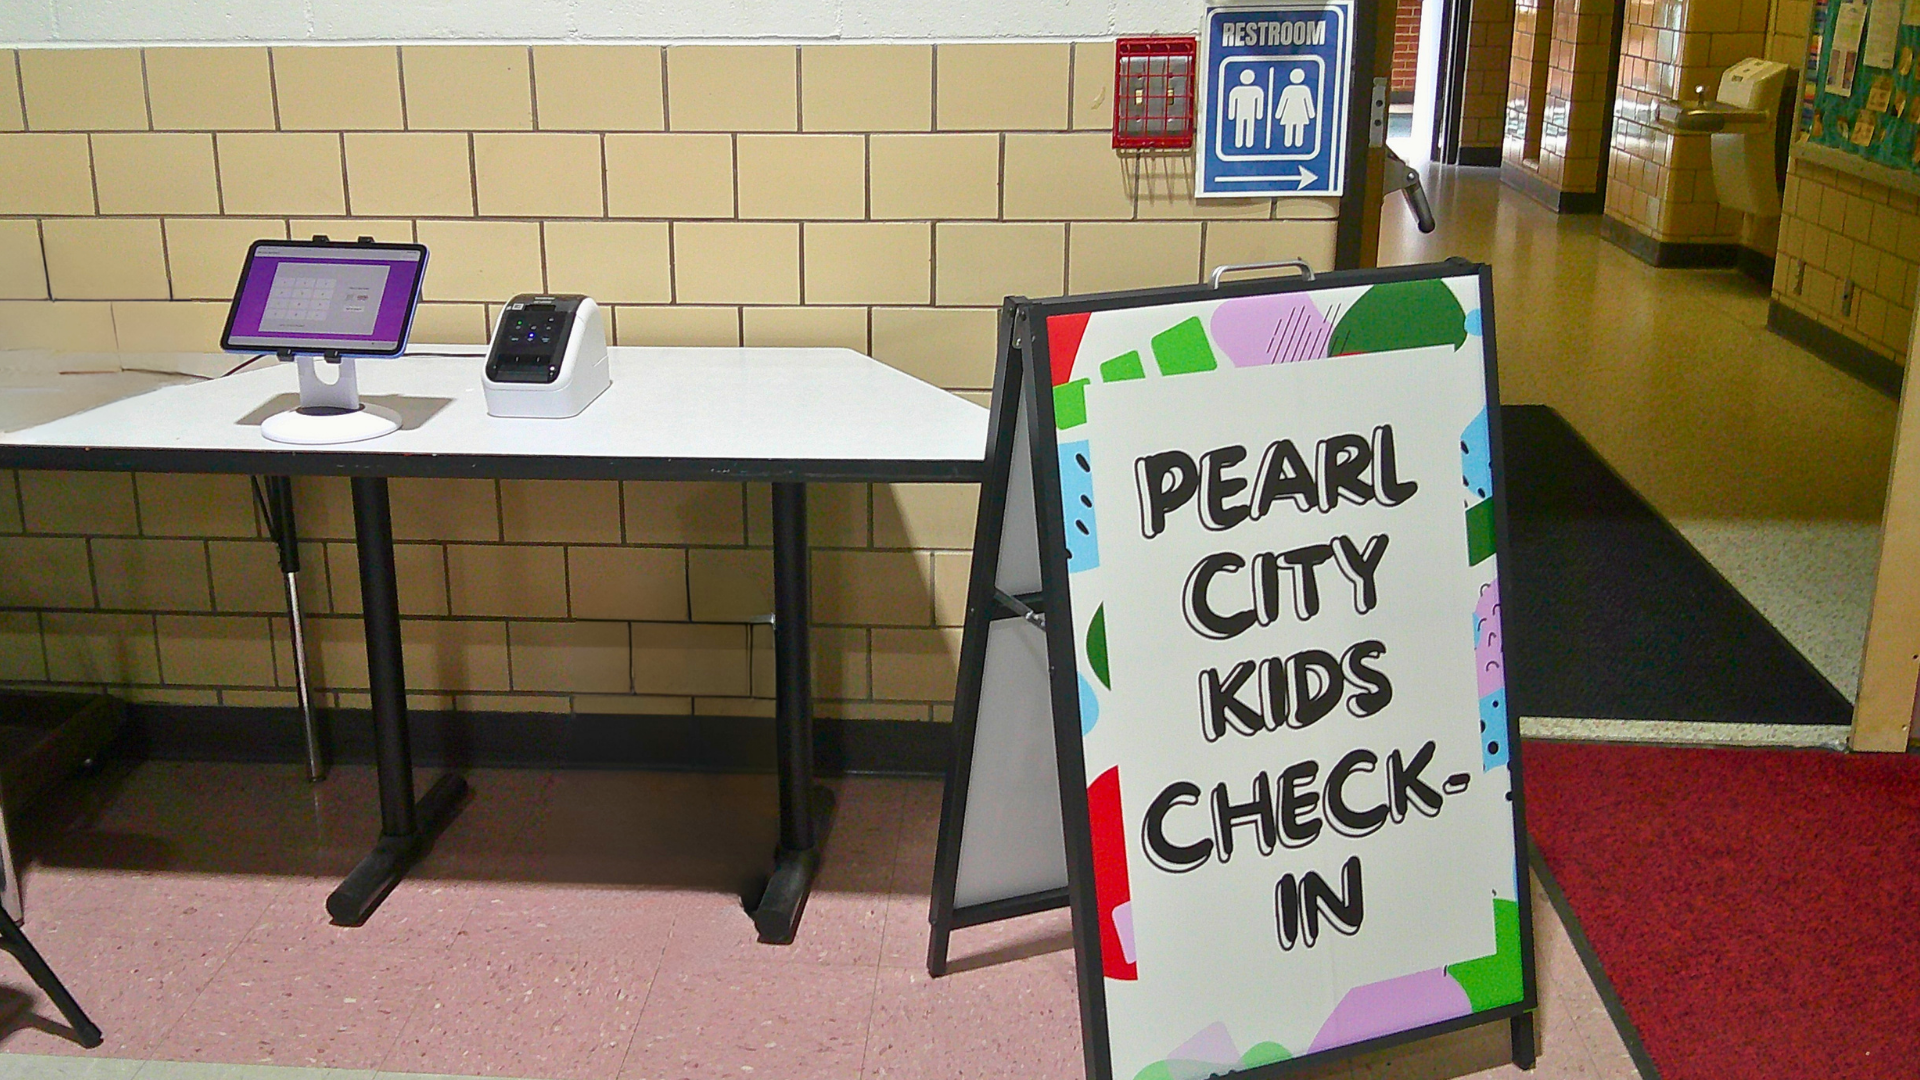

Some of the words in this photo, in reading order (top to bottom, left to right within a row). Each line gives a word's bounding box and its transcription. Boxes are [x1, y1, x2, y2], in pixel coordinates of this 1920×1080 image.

[1222, 21, 1326, 47] RESTROOM
[1135, 425, 1418, 539] PEARL
[1183, 534, 1389, 640] CITY
[1199, 640, 1392, 742] KIDS
[1142, 741, 1470, 873] CHECK-
[1275, 856, 1363, 951] IN
